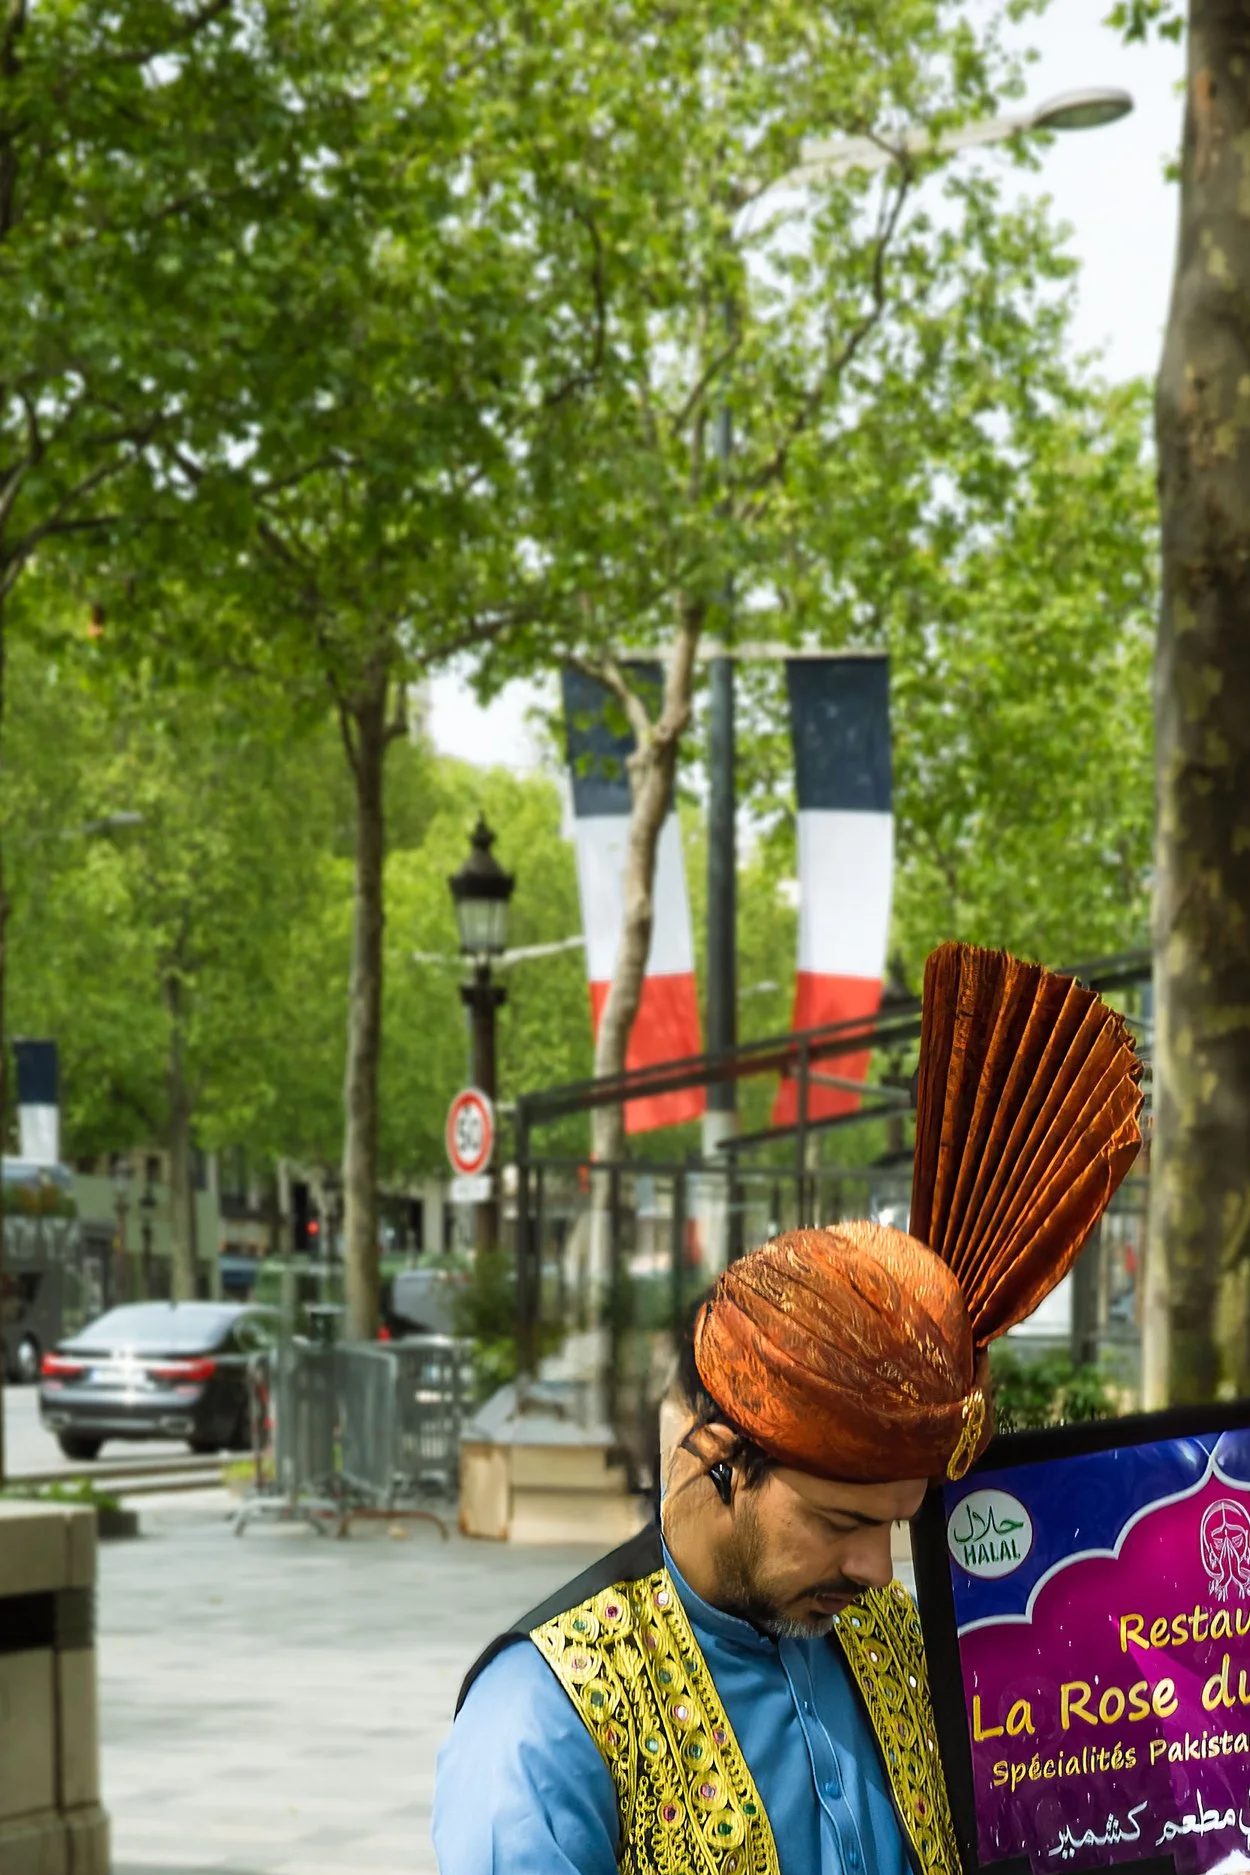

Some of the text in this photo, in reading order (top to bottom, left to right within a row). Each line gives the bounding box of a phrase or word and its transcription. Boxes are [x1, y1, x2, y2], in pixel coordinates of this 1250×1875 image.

[953, 1504, 1024, 1543] حلال
[964, 1538, 1021, 1567] HALAL
[973, 1695, 1036, 1743] La
[1061, 1677, 1179, 1731] Rose
[992, 1741, 1138, 1793] Spécialités
[1048, 1800, 1149, 1860] كشمير
[1155, 1789, 1239, 1847] مطعم
